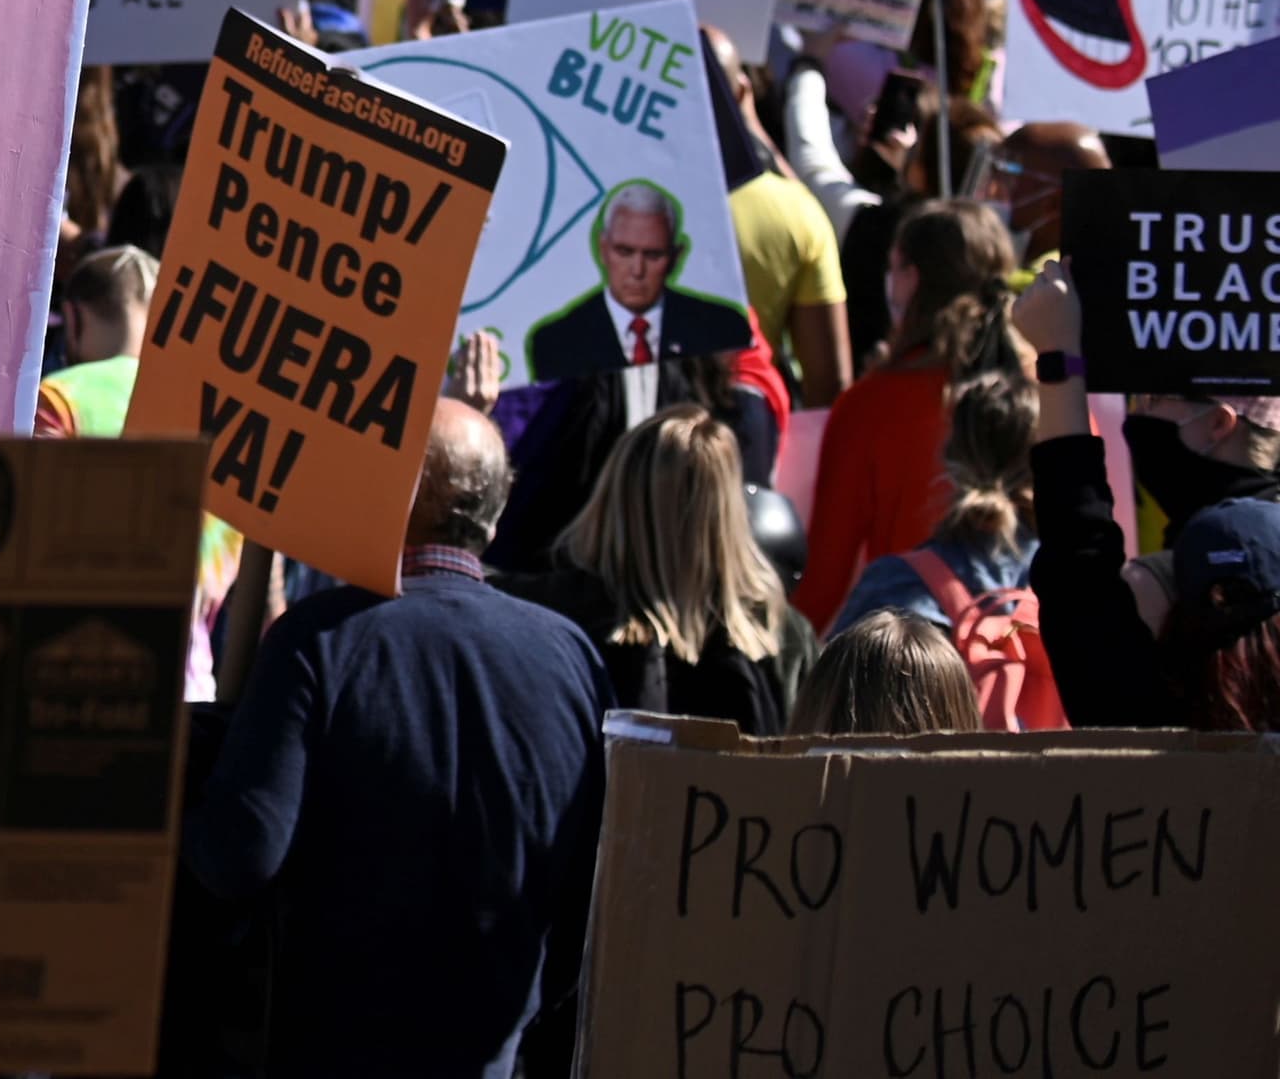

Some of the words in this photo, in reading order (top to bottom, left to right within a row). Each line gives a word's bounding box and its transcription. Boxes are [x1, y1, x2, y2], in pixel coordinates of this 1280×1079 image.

[243, 31, 468, 169] RefuseFascism.org
[546, 46, 680, 141] BLUE
[589, 10, 695, 90] VOTE
[215, 73, 454, 248] Trump/
[206, 162, 405, 319] Pence
[1126, 261, 1280, 304] BLAC
[1129, 212, 1280, 255] TRUS
[149, 256, 418, 452] ¡FUERA
[198, 378, 307, 514] YA!
[677, 783, 846, 919] PRO
[904, 789, 1213, 915] WOMEN
[674, 980, 827, 1079] PRO
[881, 973, 1173, 1079] CHOICE
